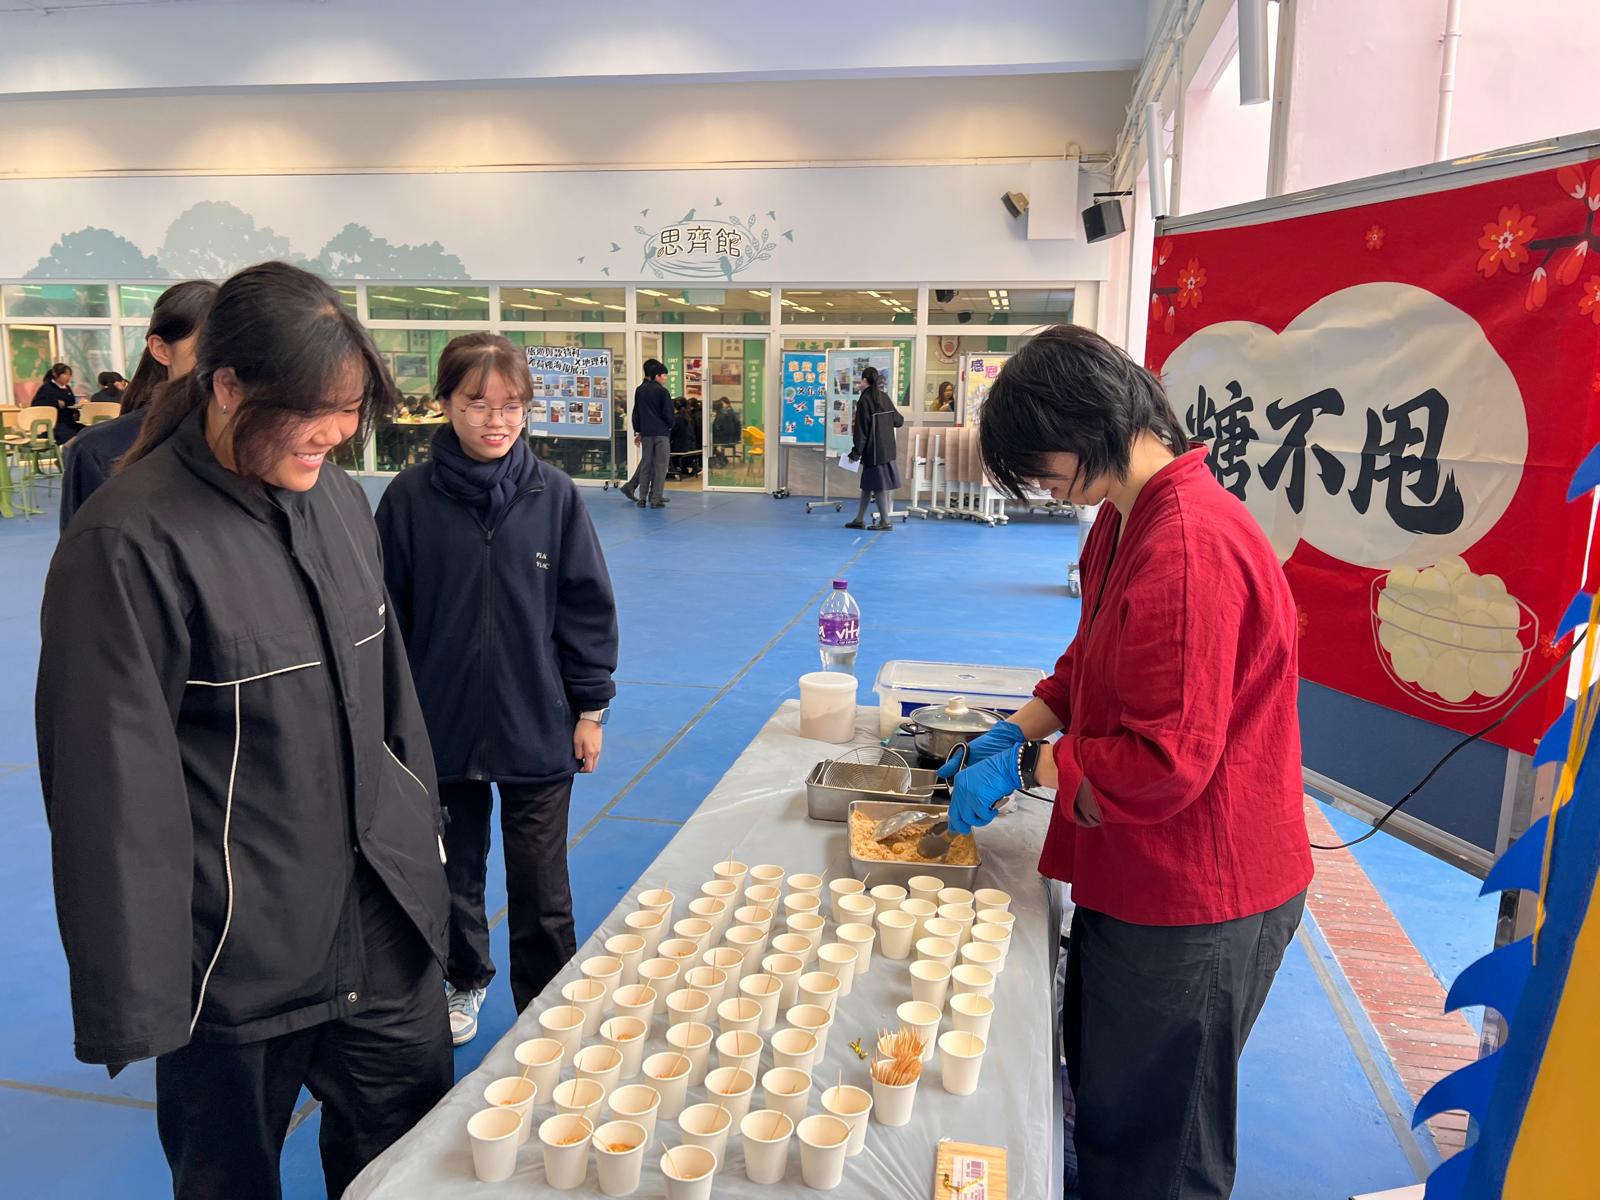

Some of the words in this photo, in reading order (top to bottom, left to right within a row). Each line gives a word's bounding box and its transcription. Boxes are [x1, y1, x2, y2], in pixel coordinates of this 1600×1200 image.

[658, 225, 742, 258] 思齊館
[1185, 379, 1465, 535] 糖不甩
